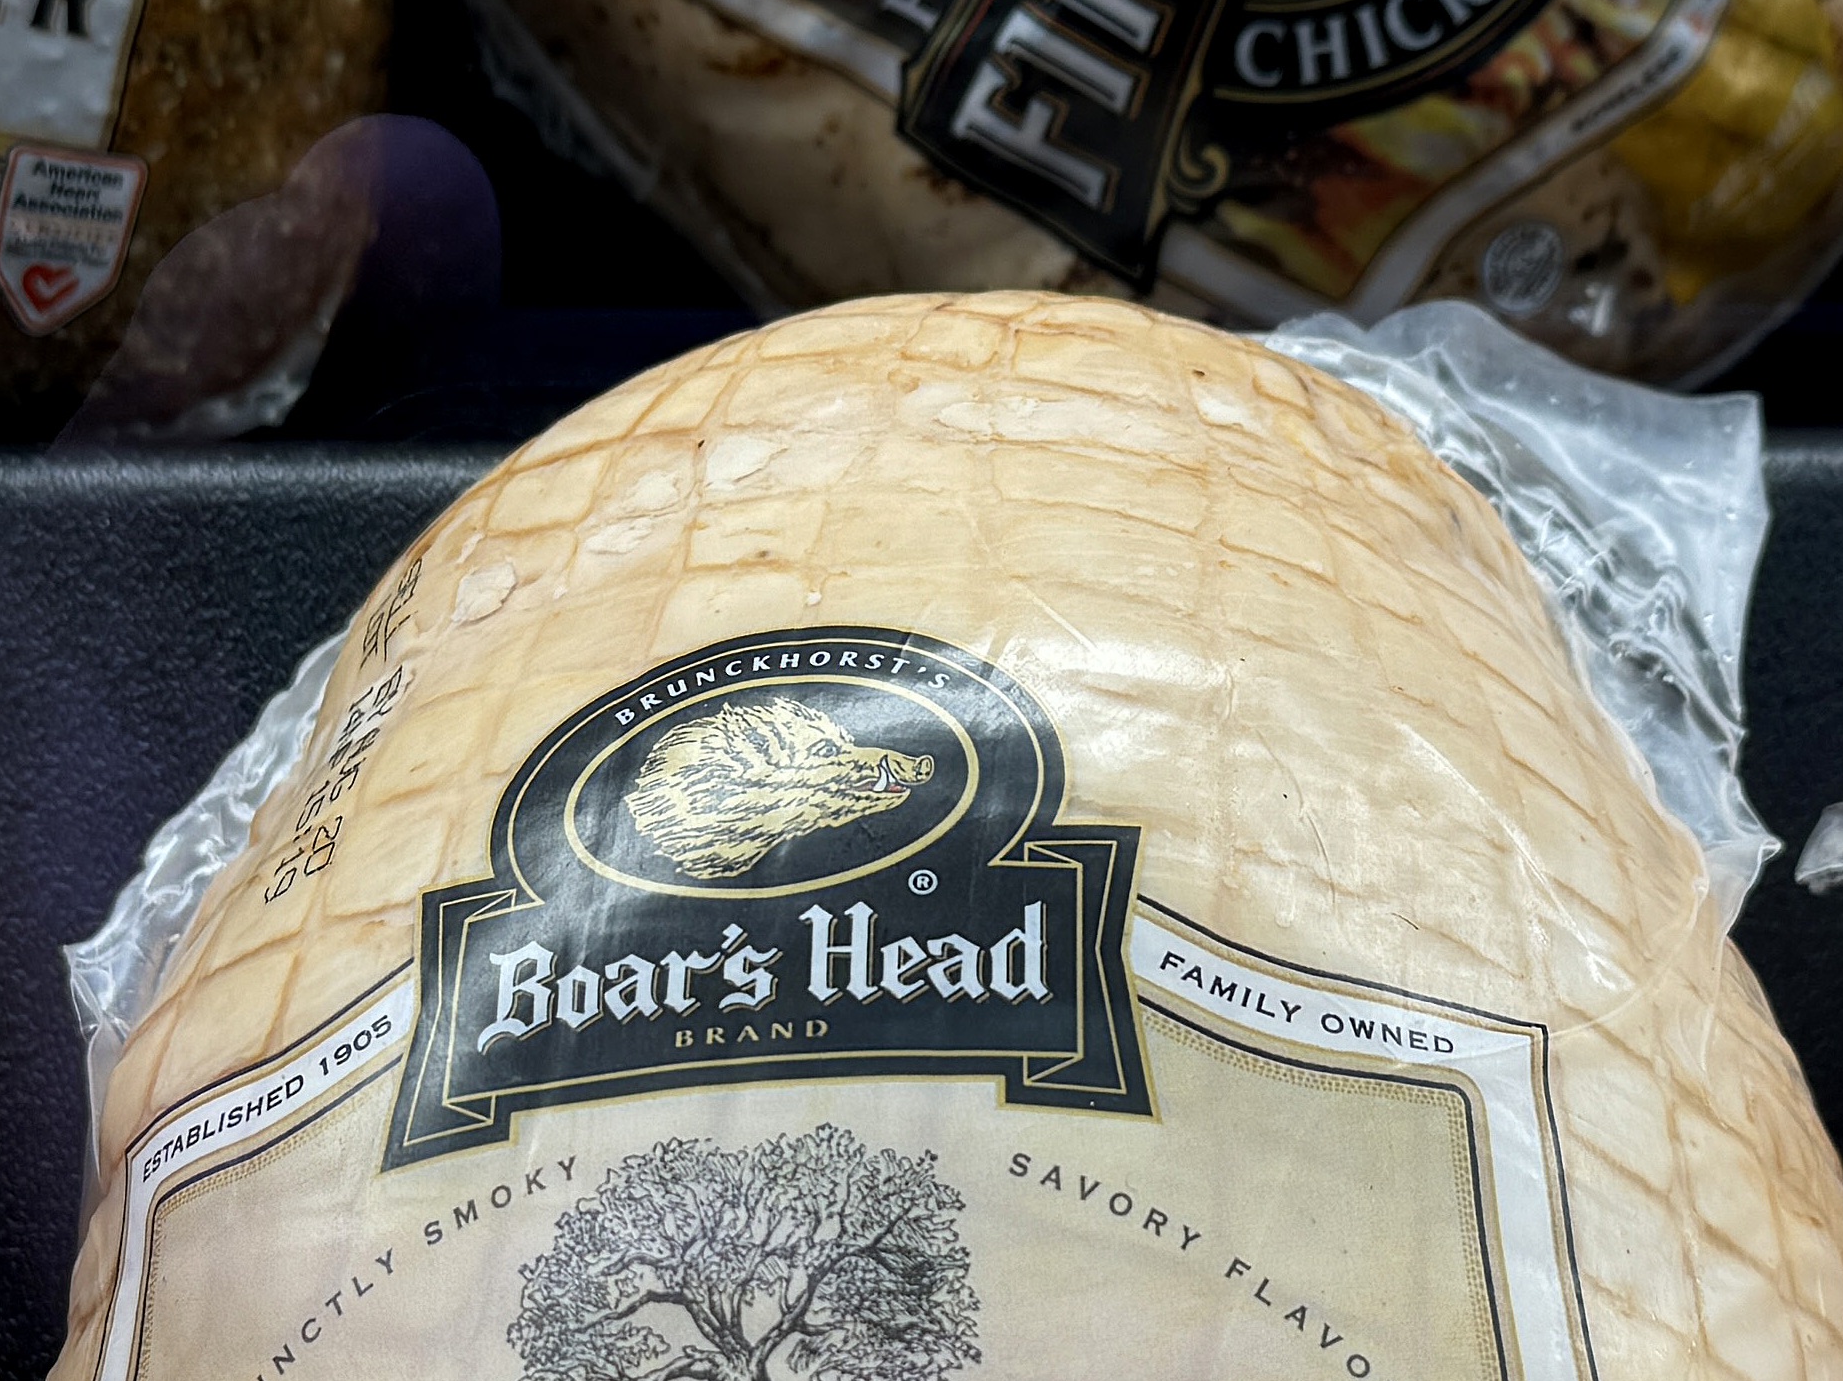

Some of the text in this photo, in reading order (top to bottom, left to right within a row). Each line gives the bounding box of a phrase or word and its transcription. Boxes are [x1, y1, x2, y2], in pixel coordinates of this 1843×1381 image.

[613, 647, 951, 727] BRUNCKHORST'S
[478, 901, 1054, 1055] Boar's Head
[1160, 949, 1456, 1056] FAMILY OWNED
[674, 1018, 830, 1050] BRAND
[142, 1014, 395, 1184] ESTABLISHED 1905
[423, 1155, 578, 1245] SMOKY
[1008, 1152, 1203, 1251] SAVORY
